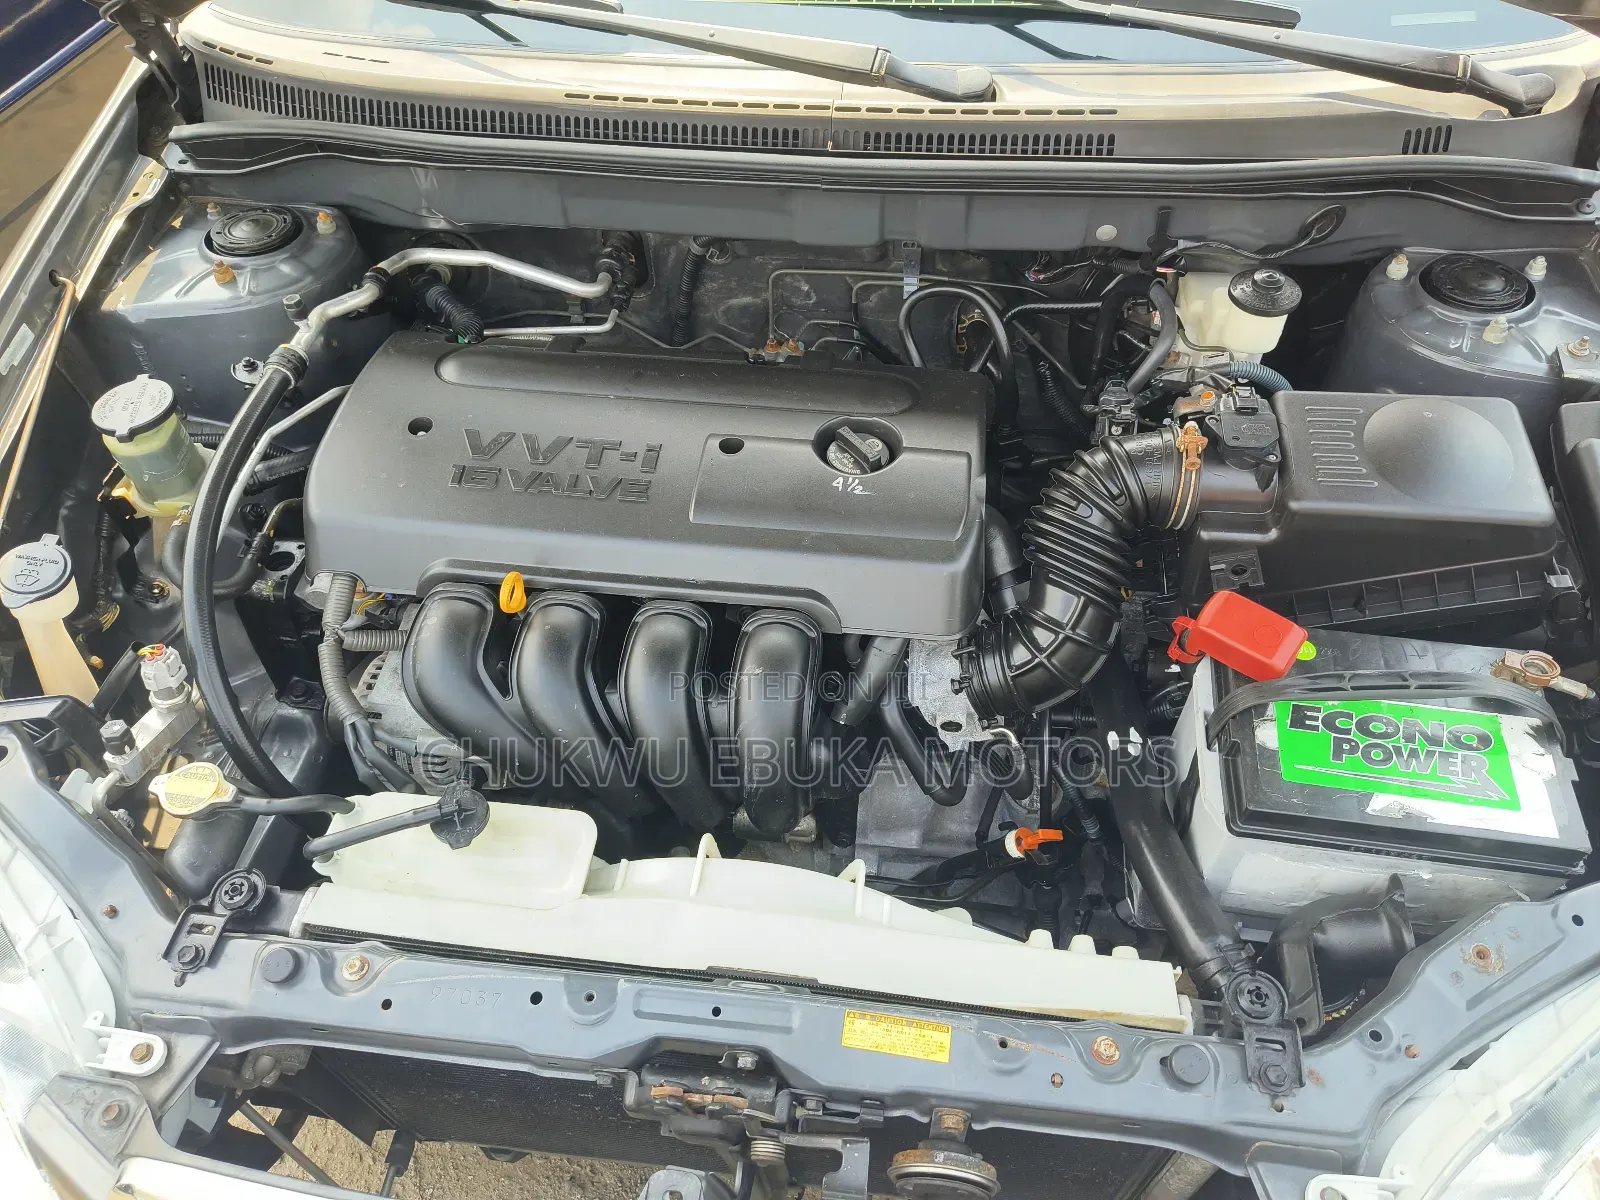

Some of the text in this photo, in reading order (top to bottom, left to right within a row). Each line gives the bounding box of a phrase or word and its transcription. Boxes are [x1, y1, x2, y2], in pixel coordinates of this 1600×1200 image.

[463, 428, 662, 474] VVT-i
[449, 463, 651, 502] 16 VALVE
[1288, 702, 1494, 752] ECONO
[180, 772, 215, 782] CAUTION
[1331, 735, 1489, 780] POWER
[430, 986, 503, 1009] 97037
[875, 1016, 949, 1033] CAUTION ATTENTION
